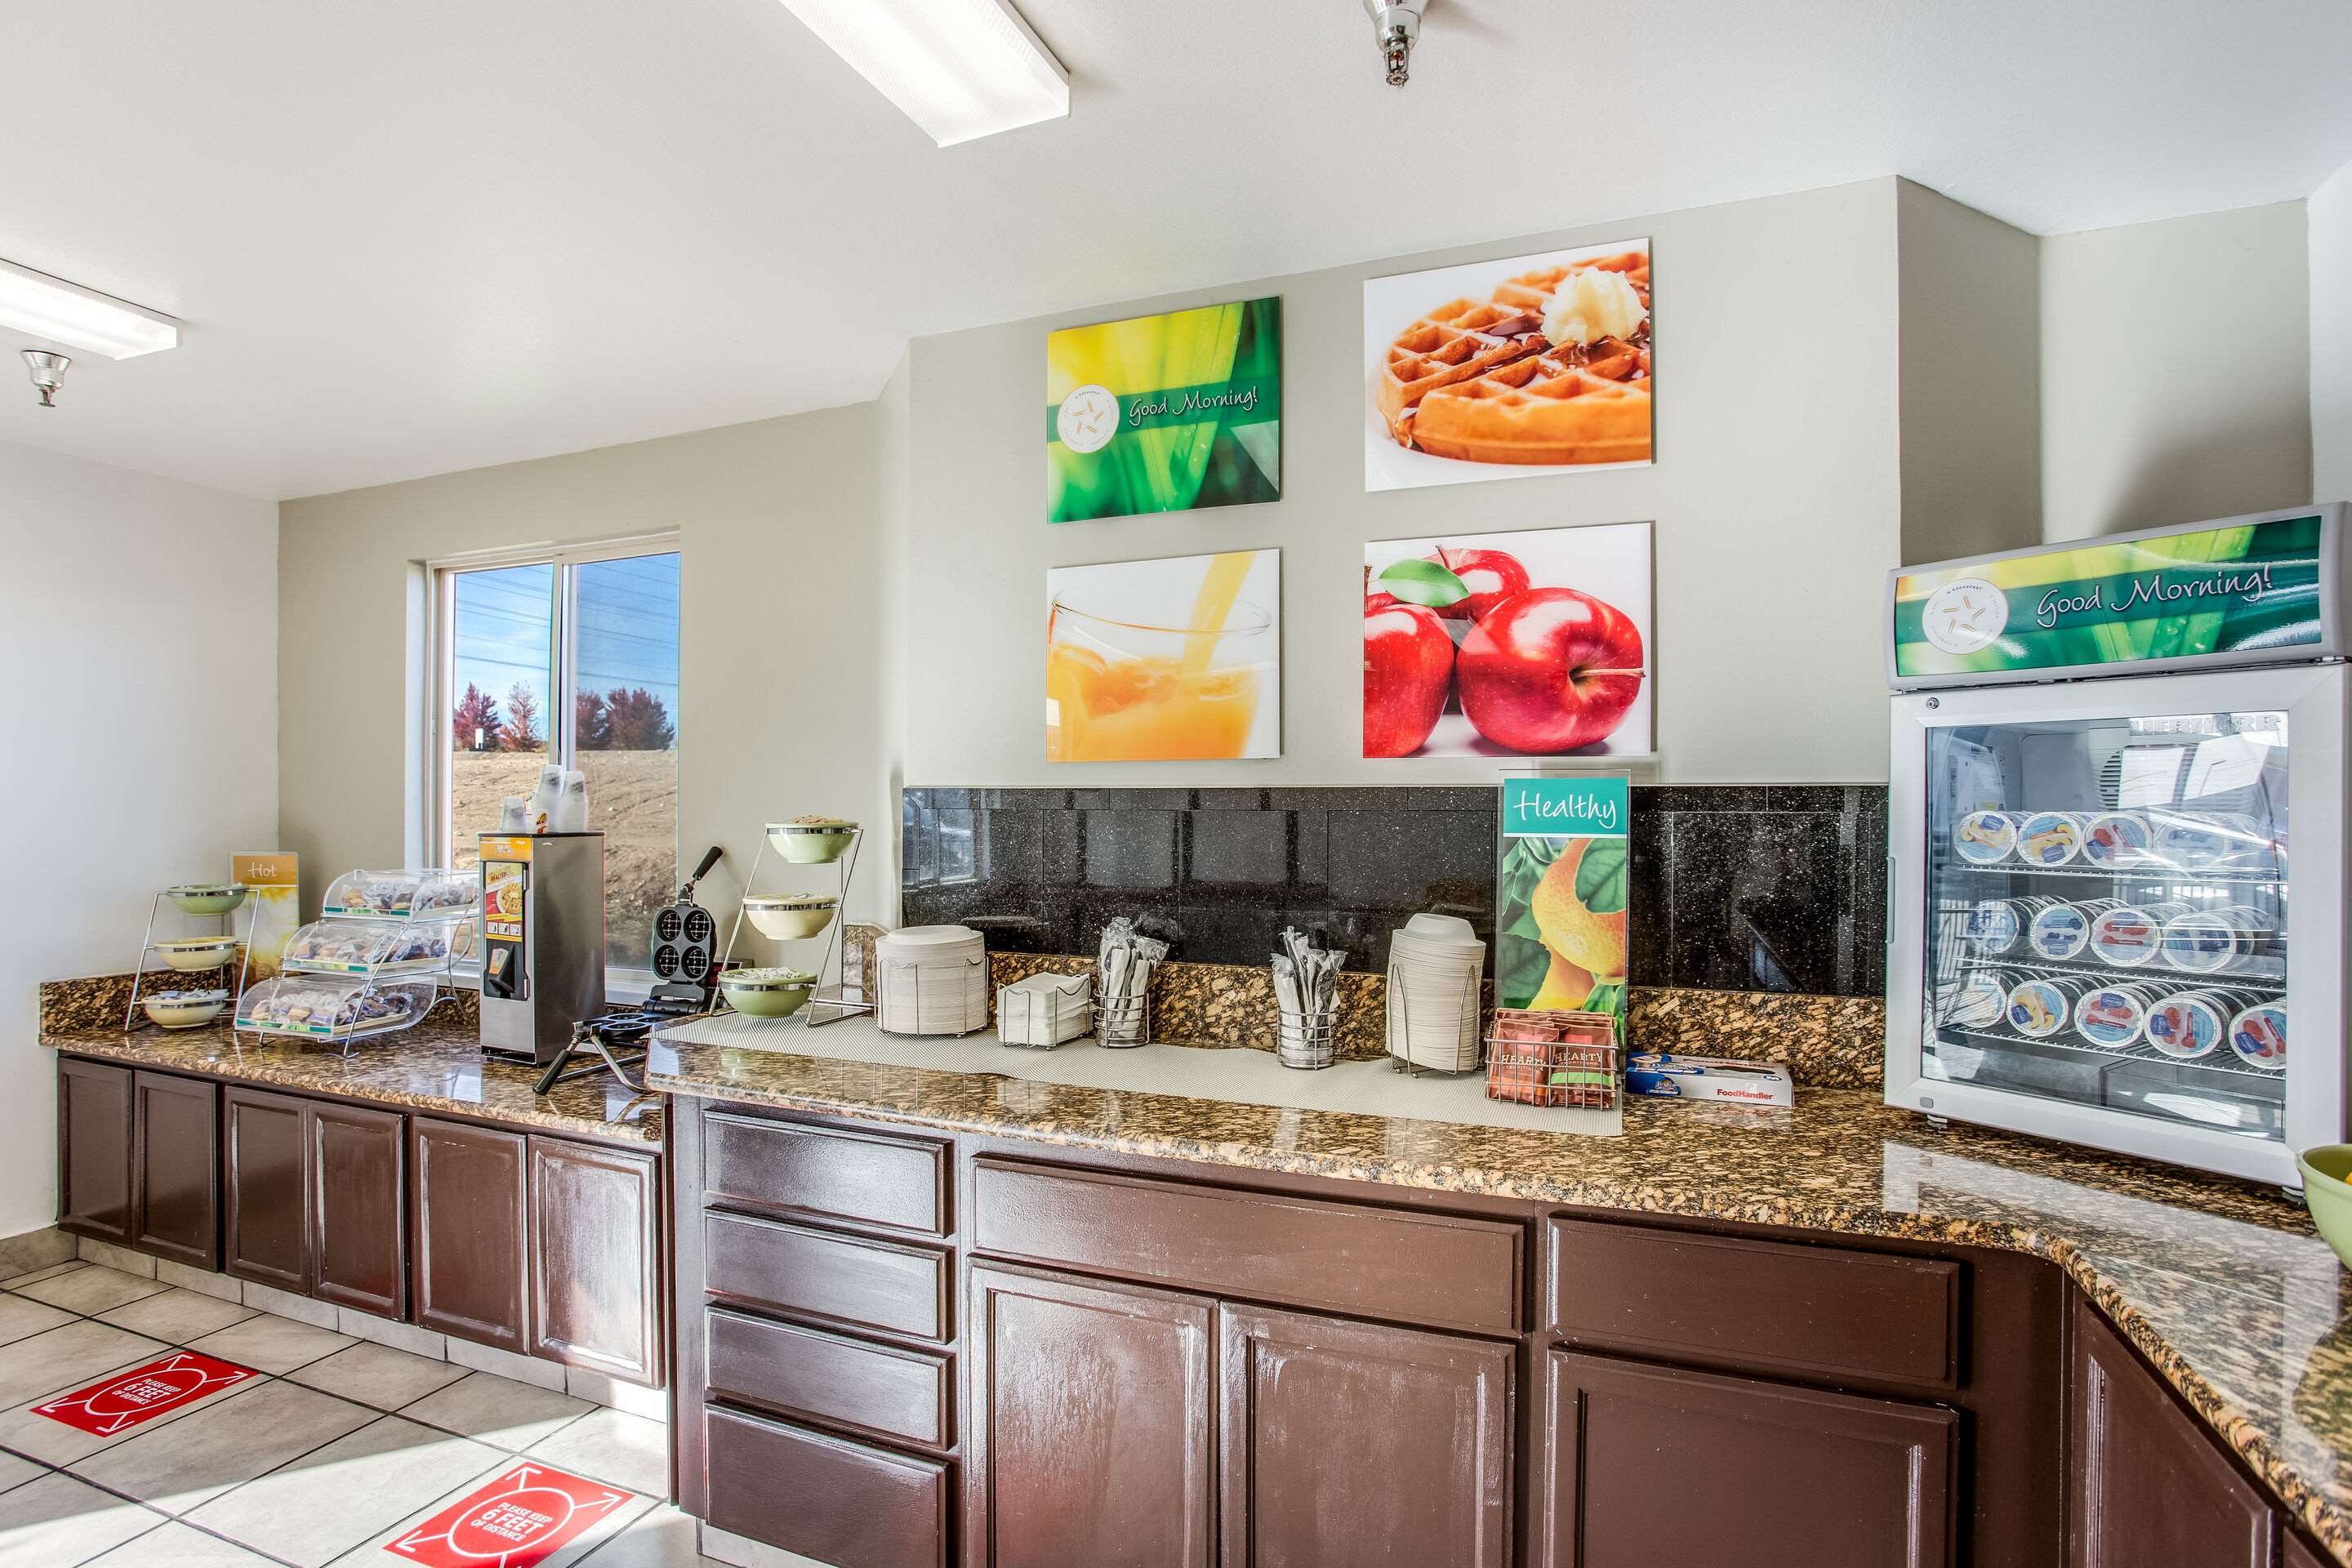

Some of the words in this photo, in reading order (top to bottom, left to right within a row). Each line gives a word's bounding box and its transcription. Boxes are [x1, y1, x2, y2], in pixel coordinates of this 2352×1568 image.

[1129, 397, 1168, 425] Good
[1172, 385, 1258, 414] Morning!
[2037, 586, 2103, 627] Good
[2110, 564, 2273, 611] Morning!
[1513, 791, 1616, 829] Healthy
[247, 862, 278, 878] Hot
[1716, 1089, 1774, 1100] FoodHandler
[123, 1383, 143, 1391] 6
[141, 1378, 167, 1388] PLEASE
[119, 1392, 153, 1405] DISTANCE
[131, 1386, 172, 1400] FEET
[481, 1508, 502, 1520] 6
[493, 1512, 545, 1535] FEET
[497, 1502, 532, 1517] PLEASE
[528, 1512, 554, 1523] KEEP
[470, 1519, 488, 1527] OF
[482, 1523, 527, 1542] DISTANCE
